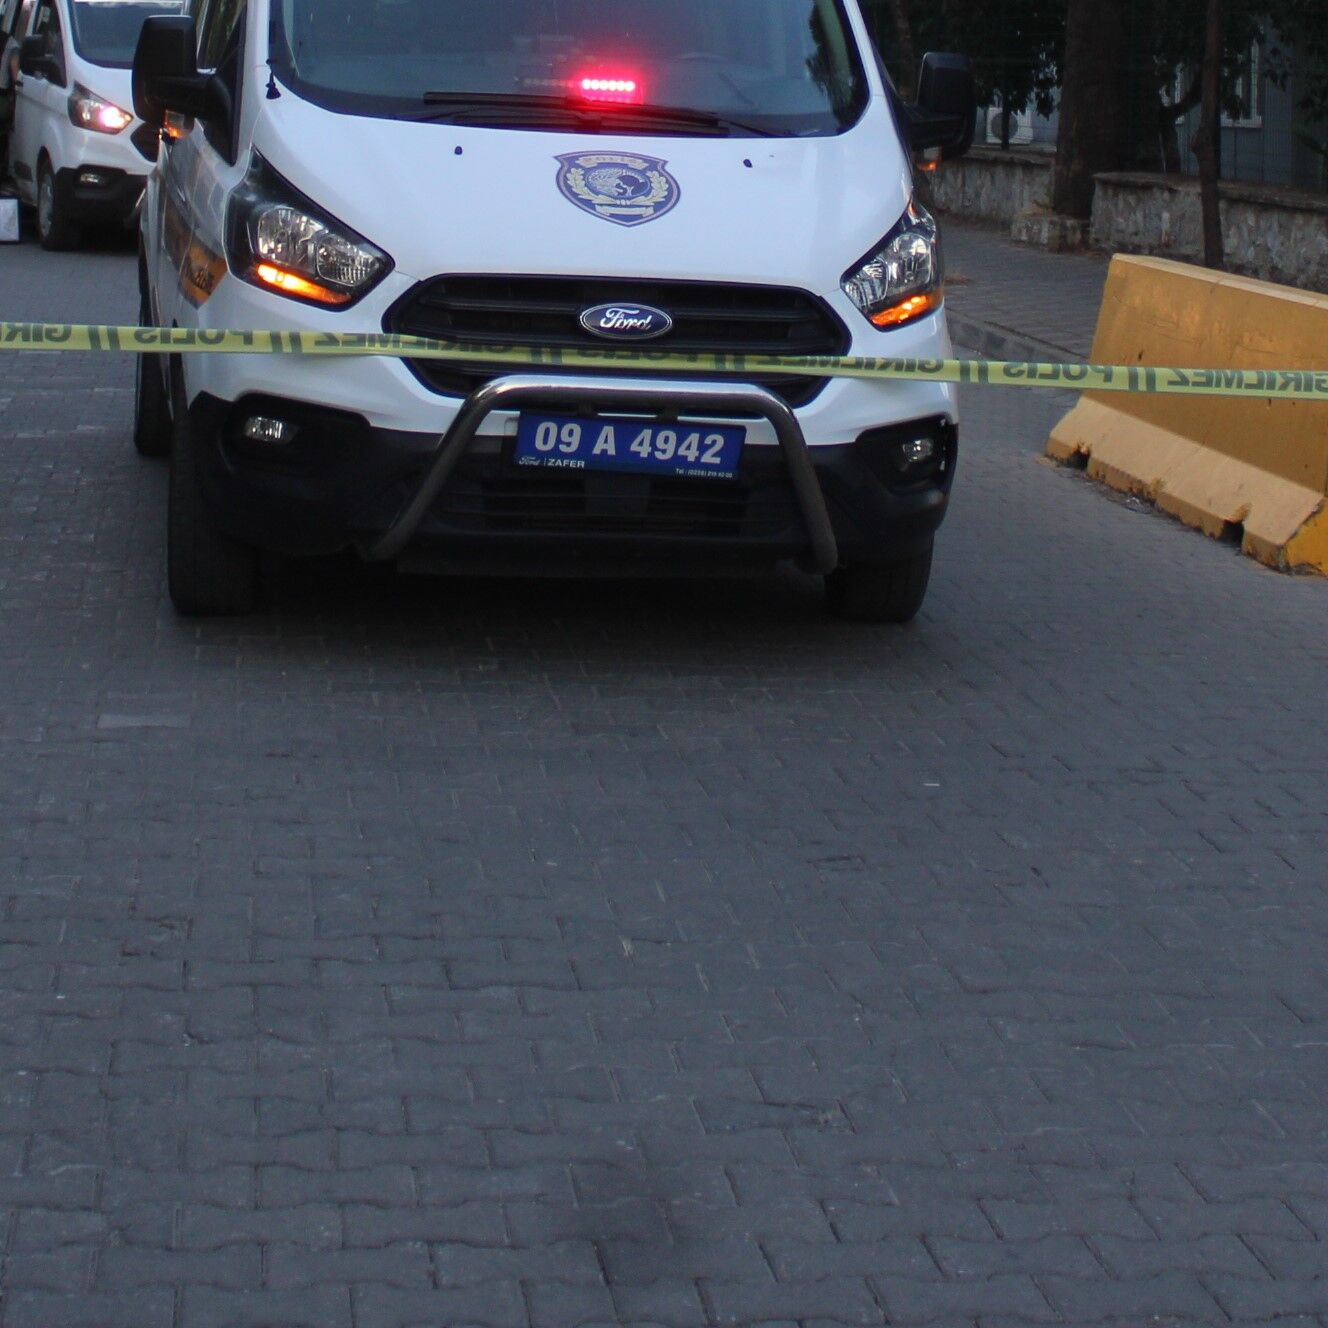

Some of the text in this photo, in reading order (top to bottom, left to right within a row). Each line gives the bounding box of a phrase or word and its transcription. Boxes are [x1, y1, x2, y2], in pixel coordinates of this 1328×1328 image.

[600, 307, 653, 331] Ford
[534, 421, 725, 465] 09 A 4942
[548, 457, 586, 470] ZAFER
